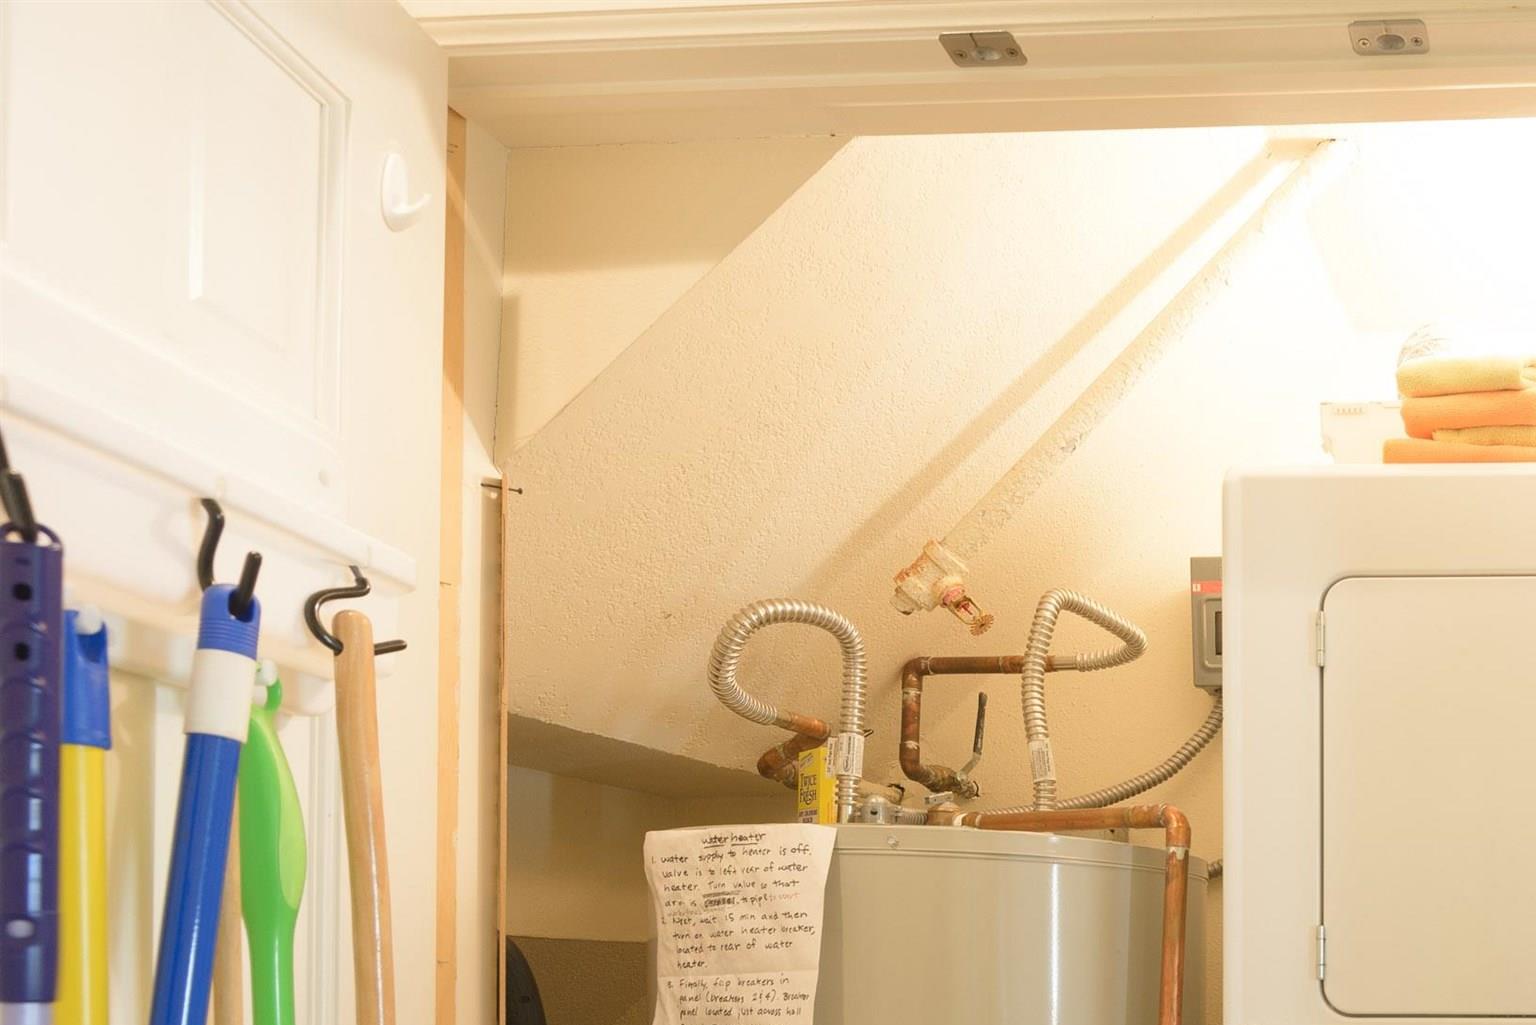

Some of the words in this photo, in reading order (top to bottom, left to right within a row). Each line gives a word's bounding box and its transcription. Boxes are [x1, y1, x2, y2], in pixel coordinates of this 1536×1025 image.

[661, 855, 688, 863] water
[780, 847, 787, 855] is
[791, 844, 812, 855] off.
[696, 867, 702, 876] is
[763, 863, 774, 872] of
[778, 864, 808, 872] water
[710, 930, 734, 938] water
[742, 926, 776, 934] heater
[747, 938, 757, 949] of
[765, 941, 792, 949] water
[738, 978, 774, 987] breakers
[780, 972, 789, 984] in
[705, 1007, 732, 1016] located
[786, 1007, 801, 1016] hall
